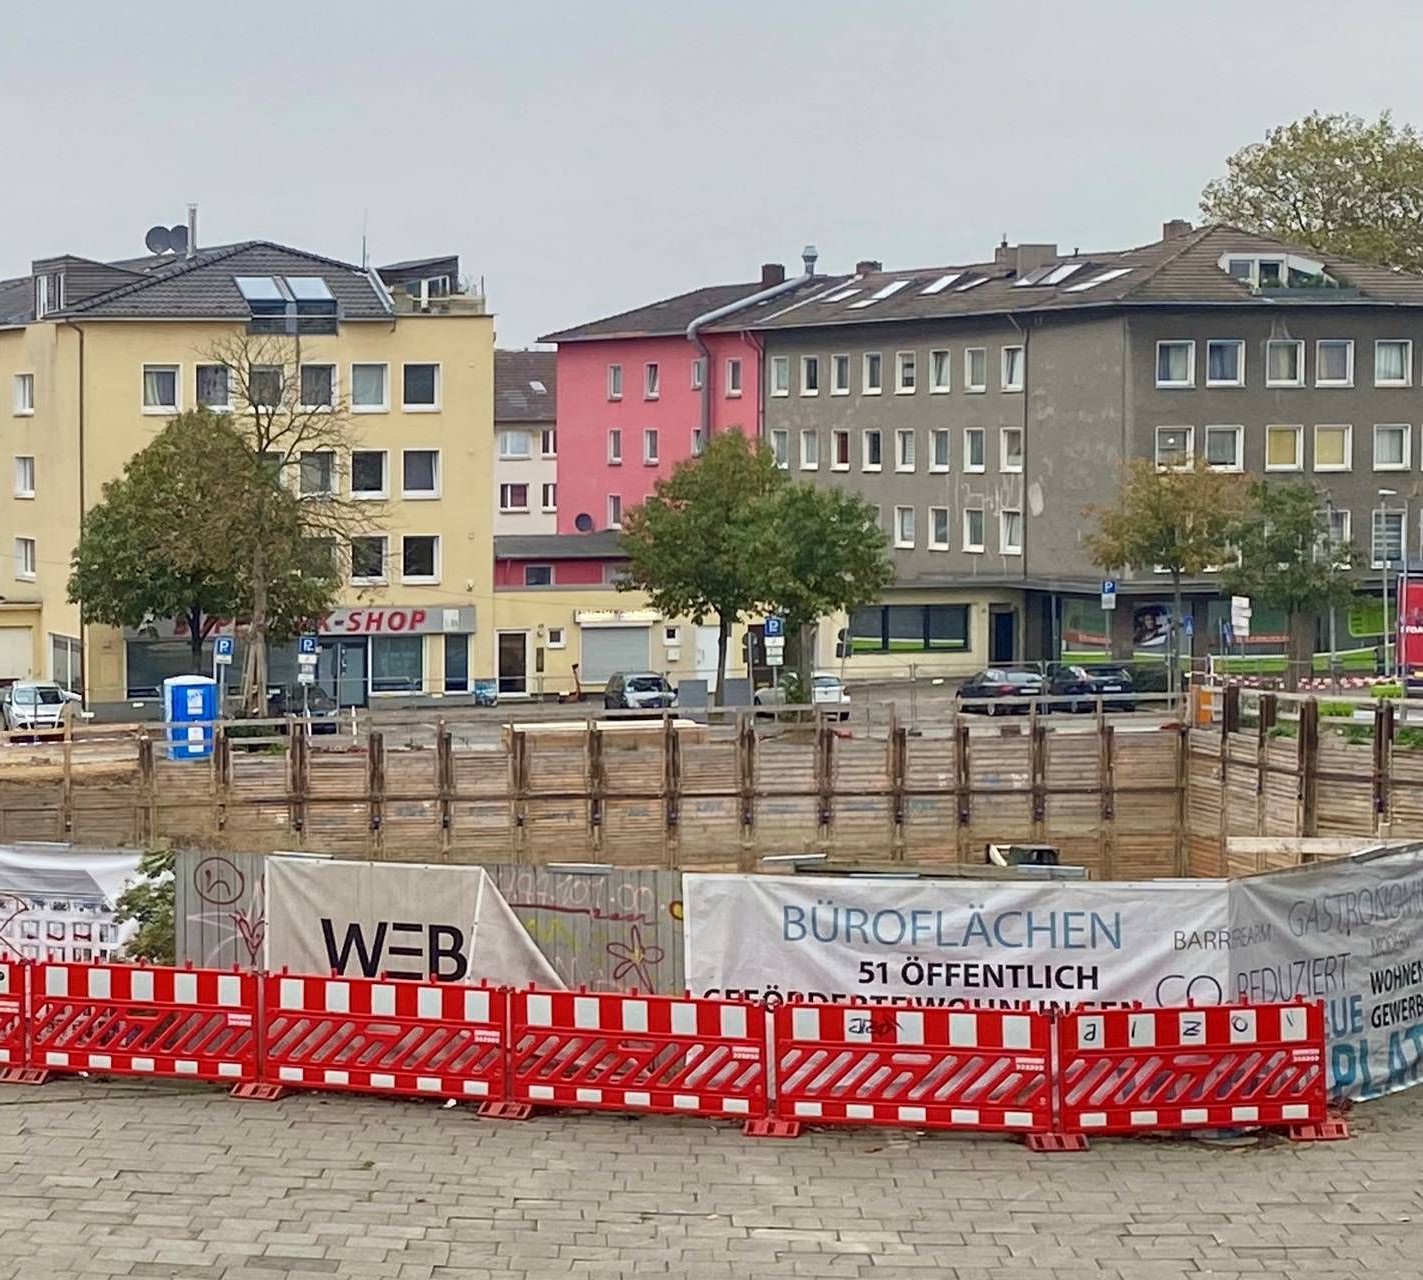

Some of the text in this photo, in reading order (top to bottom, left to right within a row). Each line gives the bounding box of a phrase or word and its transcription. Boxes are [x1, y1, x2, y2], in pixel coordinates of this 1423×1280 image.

[321, 918, 468, 982] WEB
[783, 900, 1122, 950] BÜROFLÄCHEN
[859, 956, 1099, 990] 51 ÖFFENTLICH
